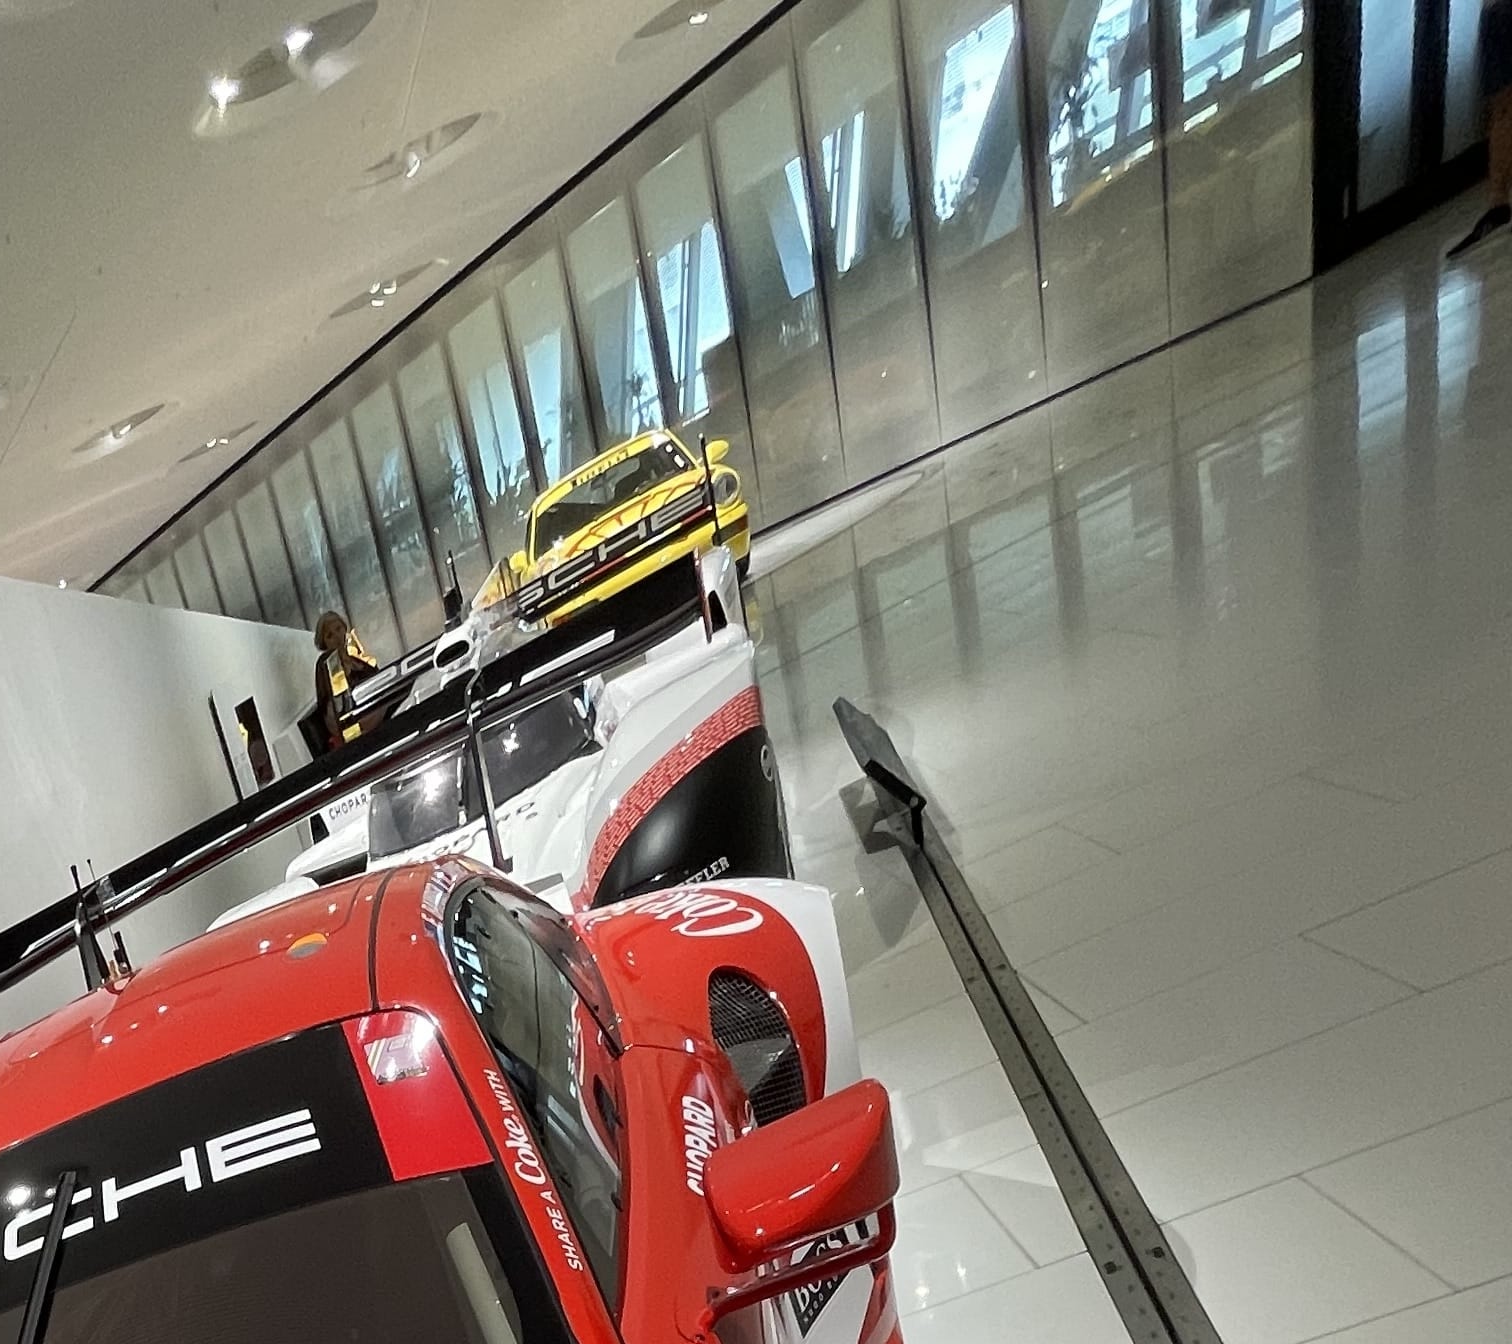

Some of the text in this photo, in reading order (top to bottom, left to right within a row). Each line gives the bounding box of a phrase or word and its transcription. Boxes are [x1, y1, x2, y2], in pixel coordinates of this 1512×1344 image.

[483, 1068, 584, 1272] SHARE A Coke WITH
